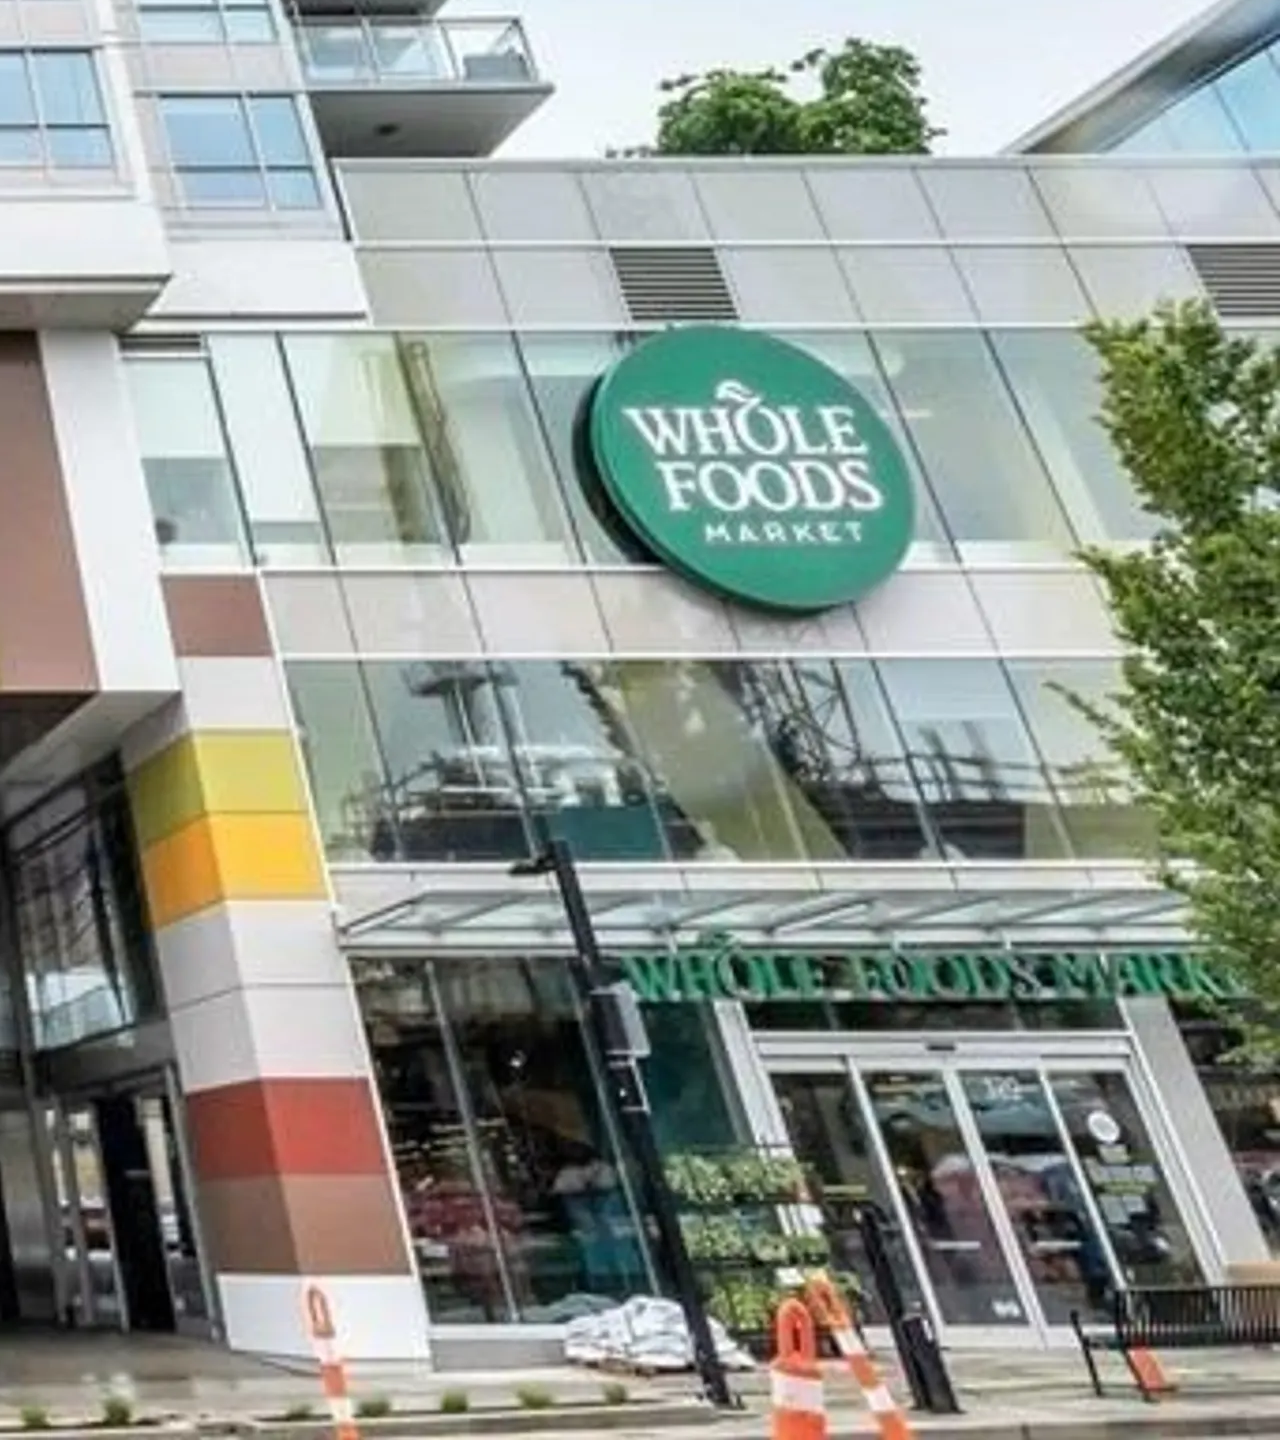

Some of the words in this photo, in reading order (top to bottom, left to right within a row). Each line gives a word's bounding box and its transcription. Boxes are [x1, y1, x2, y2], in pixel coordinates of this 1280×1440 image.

[621, 398, 870, 456] WHOLE
[656, 460, 885, 512] FOODS
[703, 520, 864, 544] MARKET
[618, 948, 826, 1001] WHOLE
[848, 948, 1042, 1001] FOODS
